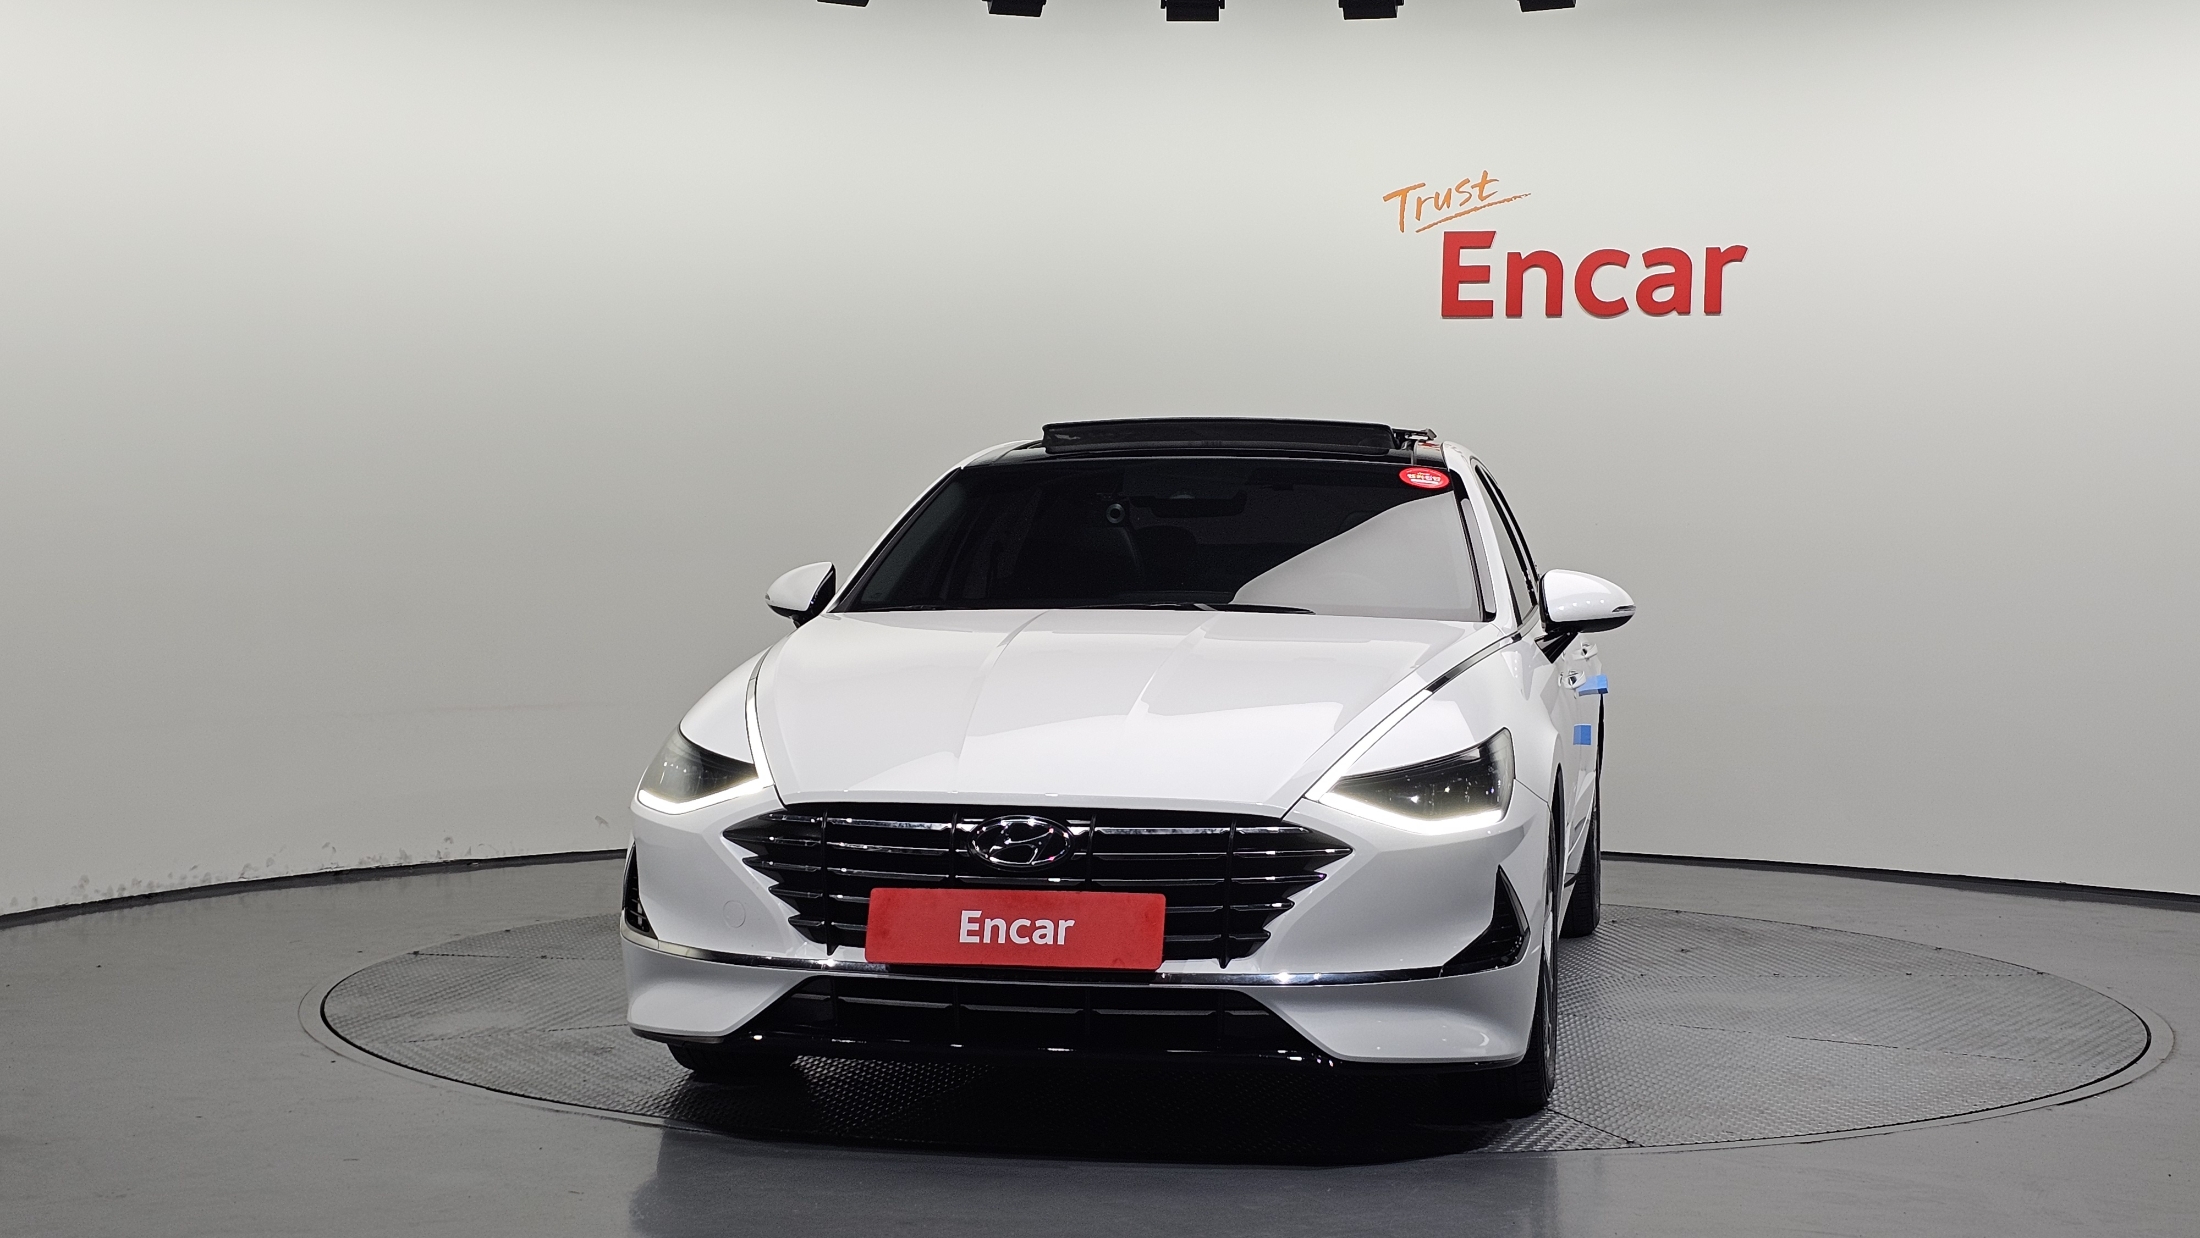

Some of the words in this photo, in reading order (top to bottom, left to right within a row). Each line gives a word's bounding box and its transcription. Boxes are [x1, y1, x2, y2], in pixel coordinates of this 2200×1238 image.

[1383, 170, 1501, 233] Trust
[1441, 230, 1749, 319] Encar
[959, 910, 1076, 945] Encar
